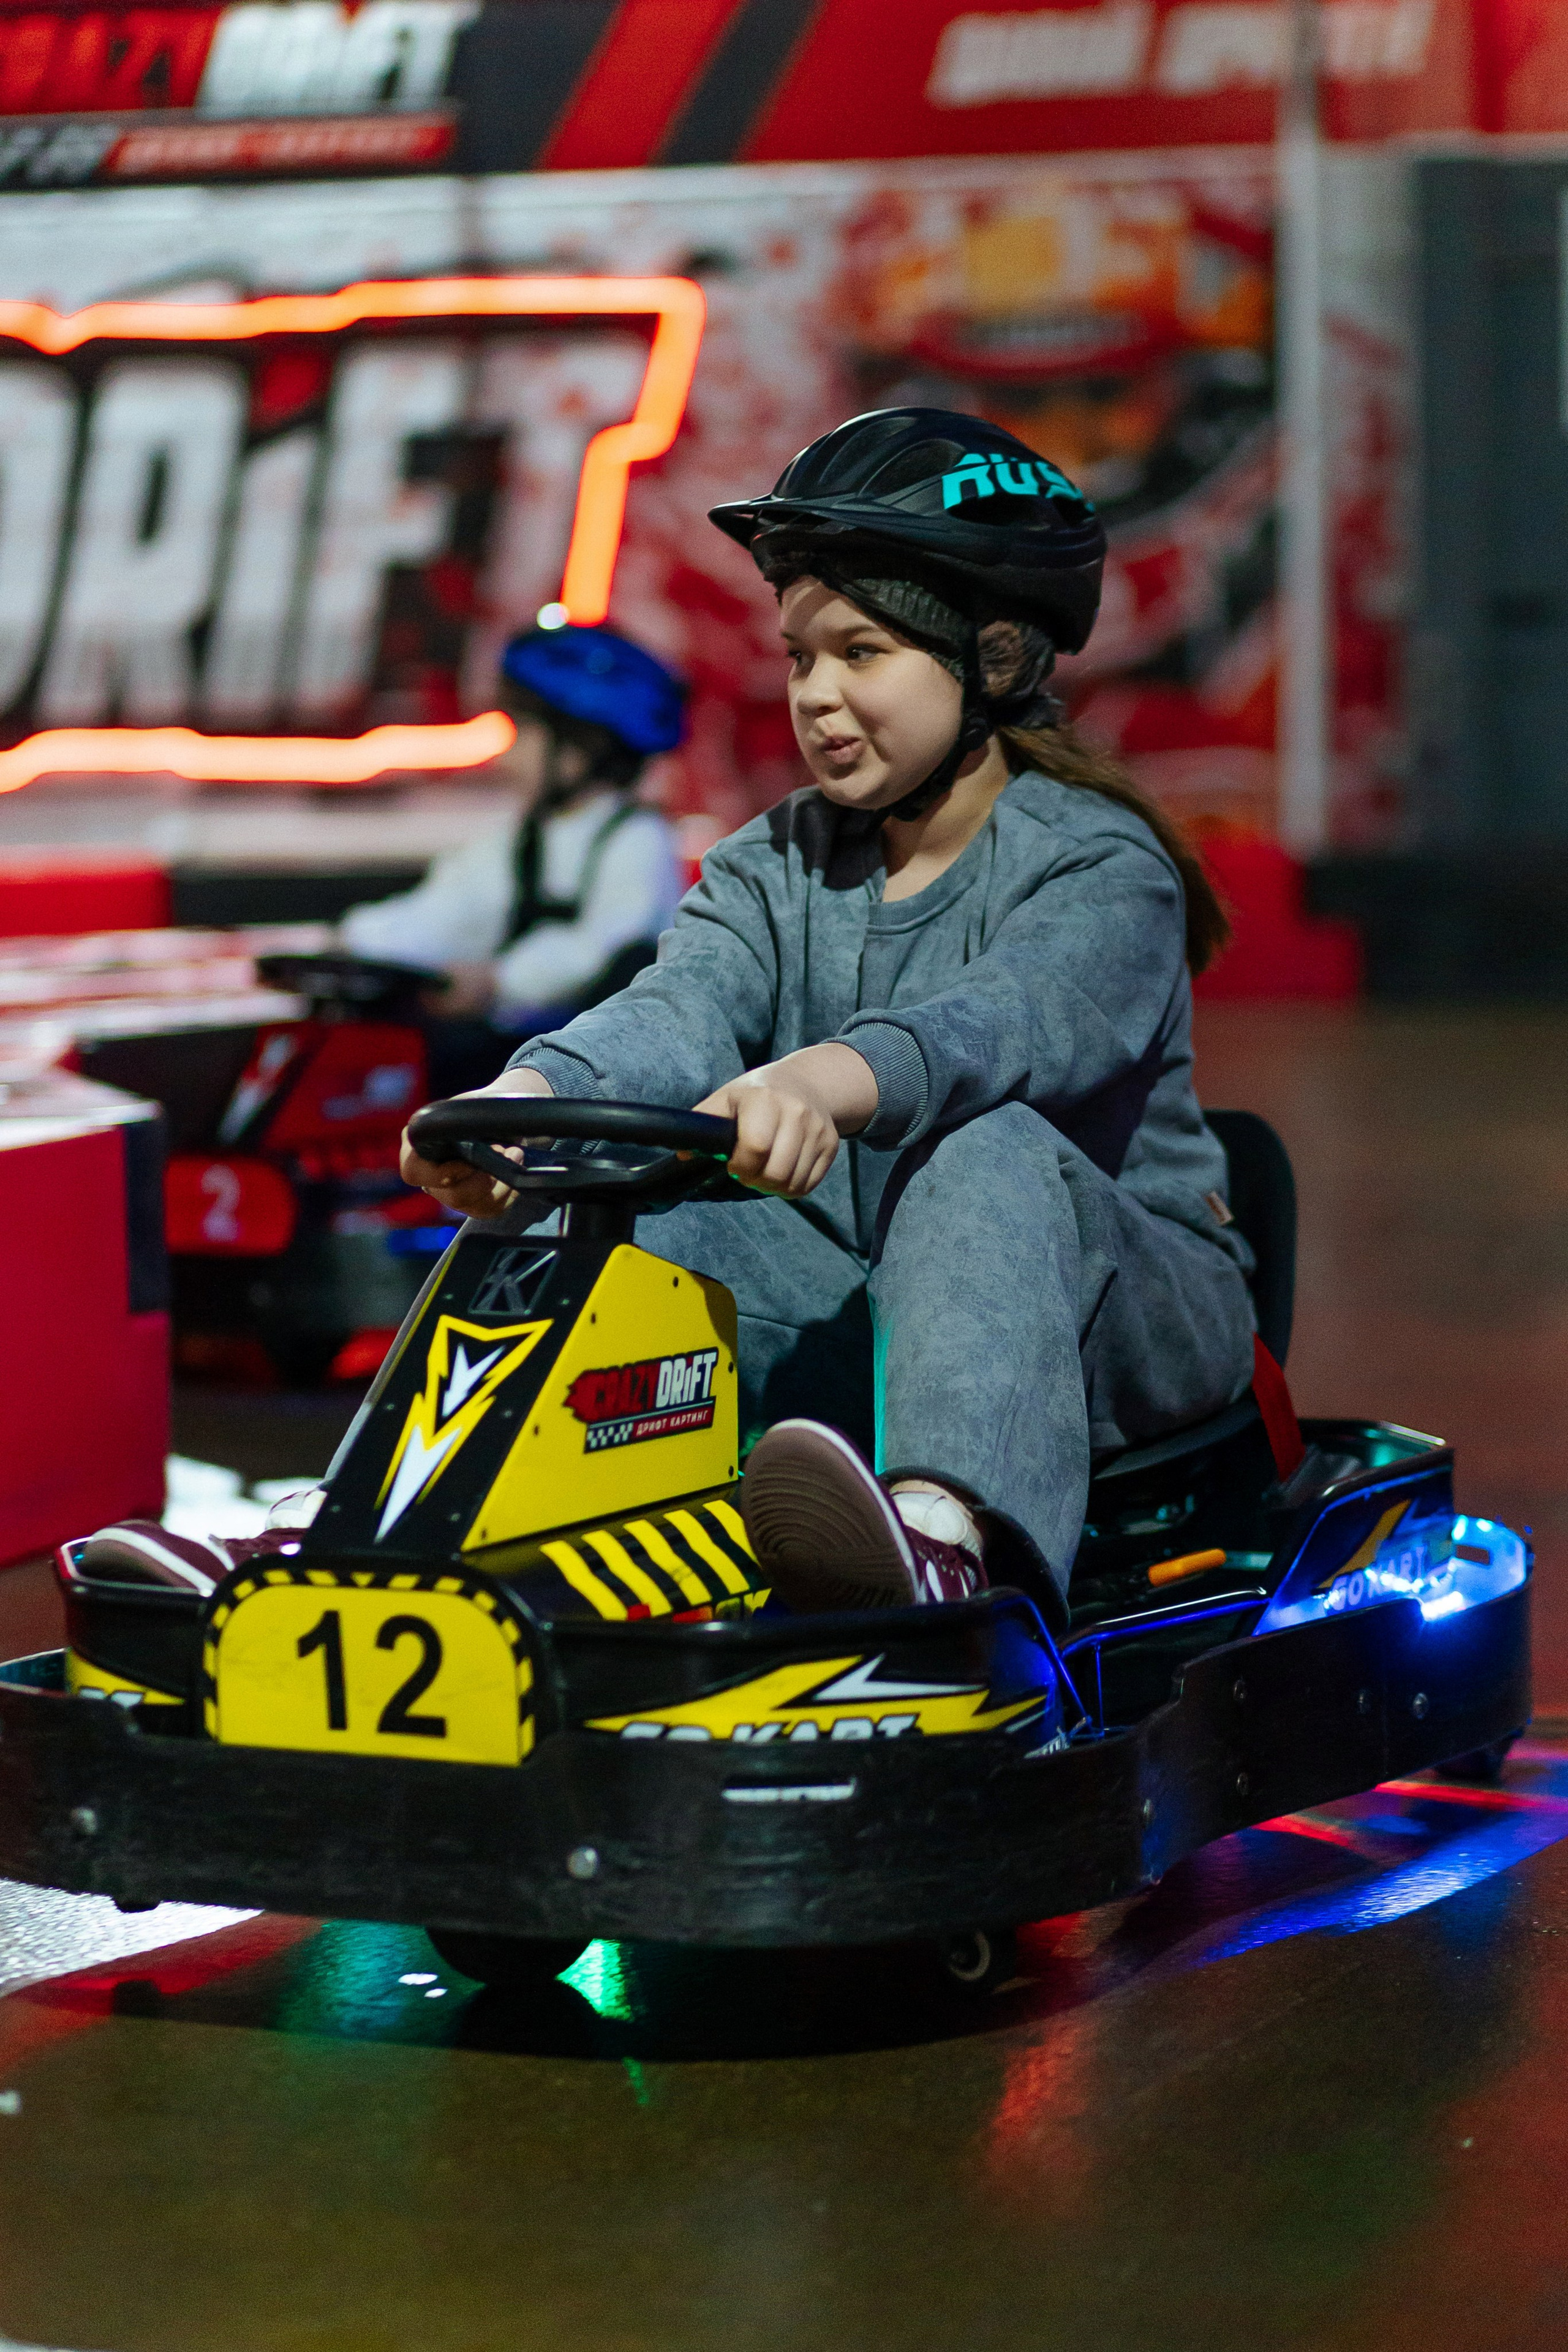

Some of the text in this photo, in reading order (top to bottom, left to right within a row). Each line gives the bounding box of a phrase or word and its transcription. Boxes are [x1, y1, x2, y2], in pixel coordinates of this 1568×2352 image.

[200, 1163, 241, 1243] 2
[636, 1410, 708, 1436] ДРИФТ КАРТИНГ
[297, 1610, 447, 1740] 12
